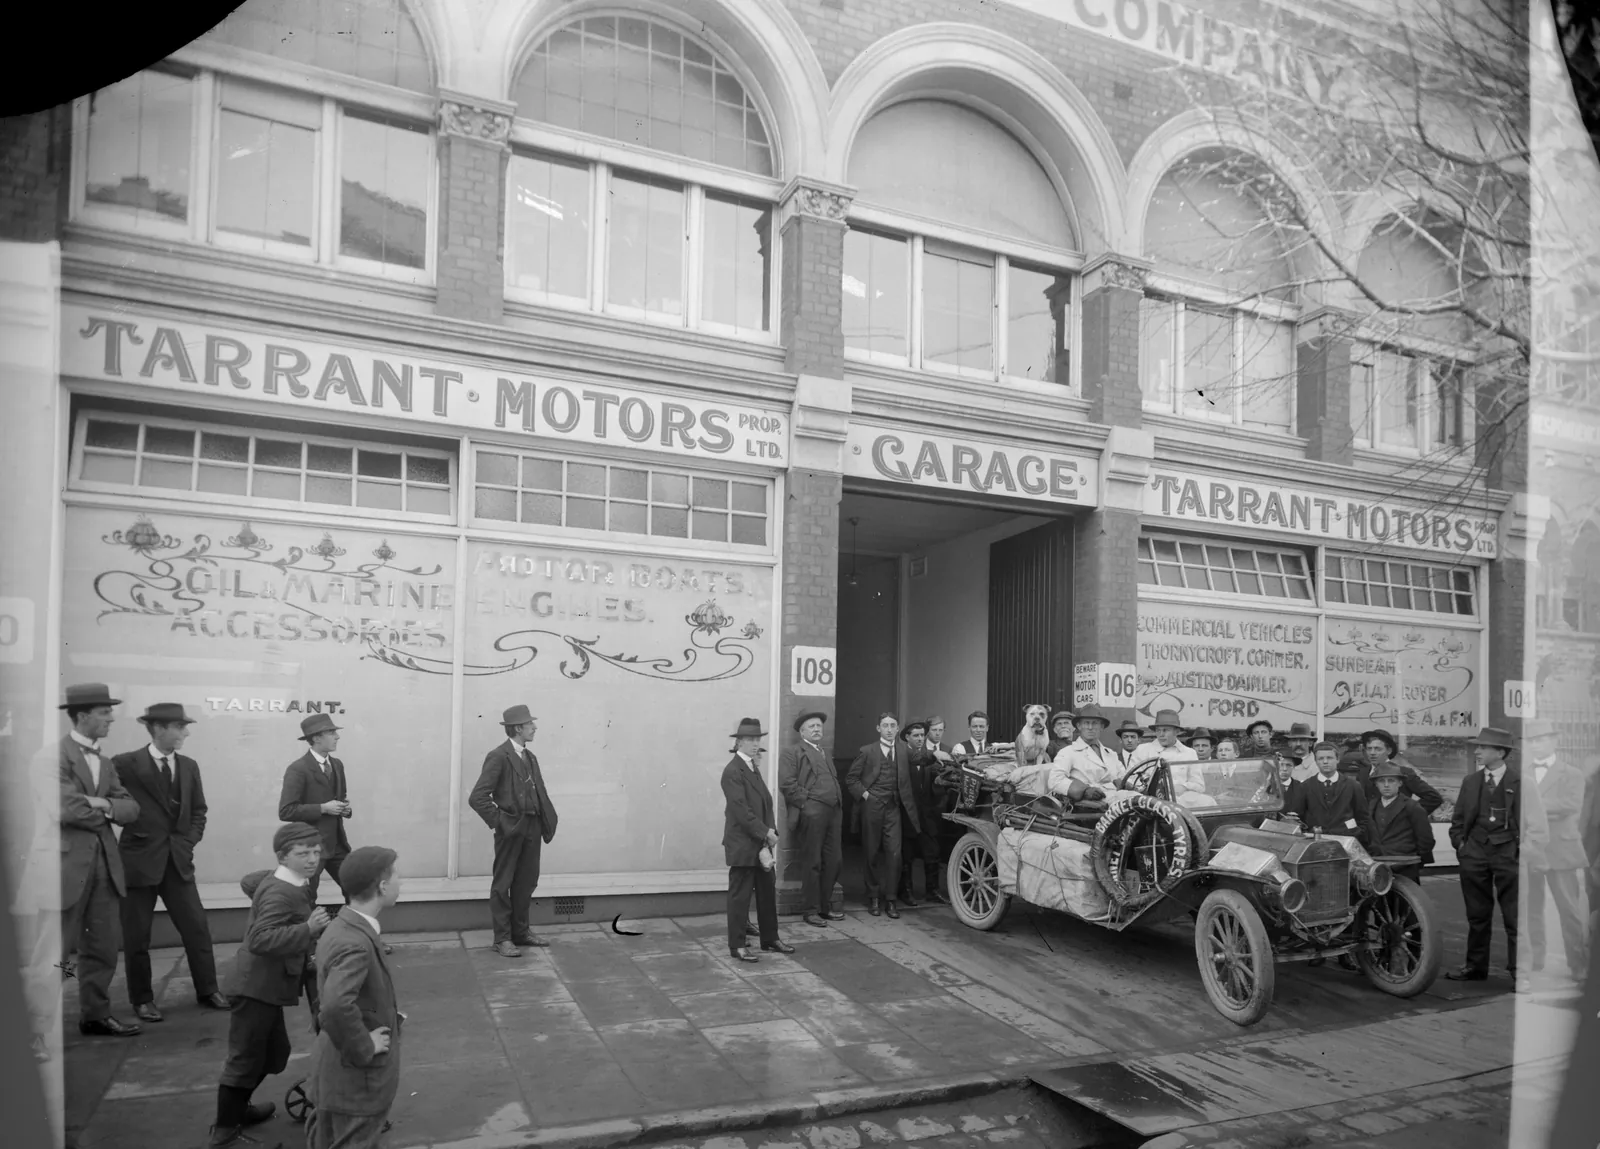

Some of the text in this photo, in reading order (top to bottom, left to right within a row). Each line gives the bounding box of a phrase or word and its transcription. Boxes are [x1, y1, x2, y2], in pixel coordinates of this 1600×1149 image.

[79, 316, 734, 453] TARRANT MOTORS
[738, 413, 783, 435] PROP.
[746, 439, 783, 460] LTD.
[871, 434, 1078, 500] GARAGE
[1151, 473, 1474, 551] TARRANT MOTORS
[186, 566, 259, 599] OIL
[281, 573, 453, 610] MARINE
[170, 607, 446, 648] ACCESSORIES
[1136, 614, 1313, 645] COMMERCIAL VEHICLES
[796, 657, 834, 685] 108
[1075, 664, 1097, 674] BEWARE
[1075, 680, 1096, 692] MOTOR
[1076, 694, 1094, 703] CARS
[1104, 672, 1135, 698] 106
[1207, 698, 1260, 718] FORD
[1095, 797, 1134, 834] BARNET
[1137, 795, 1178, 825] GLASS
[1168, 825, 1188, 879] TYRES
